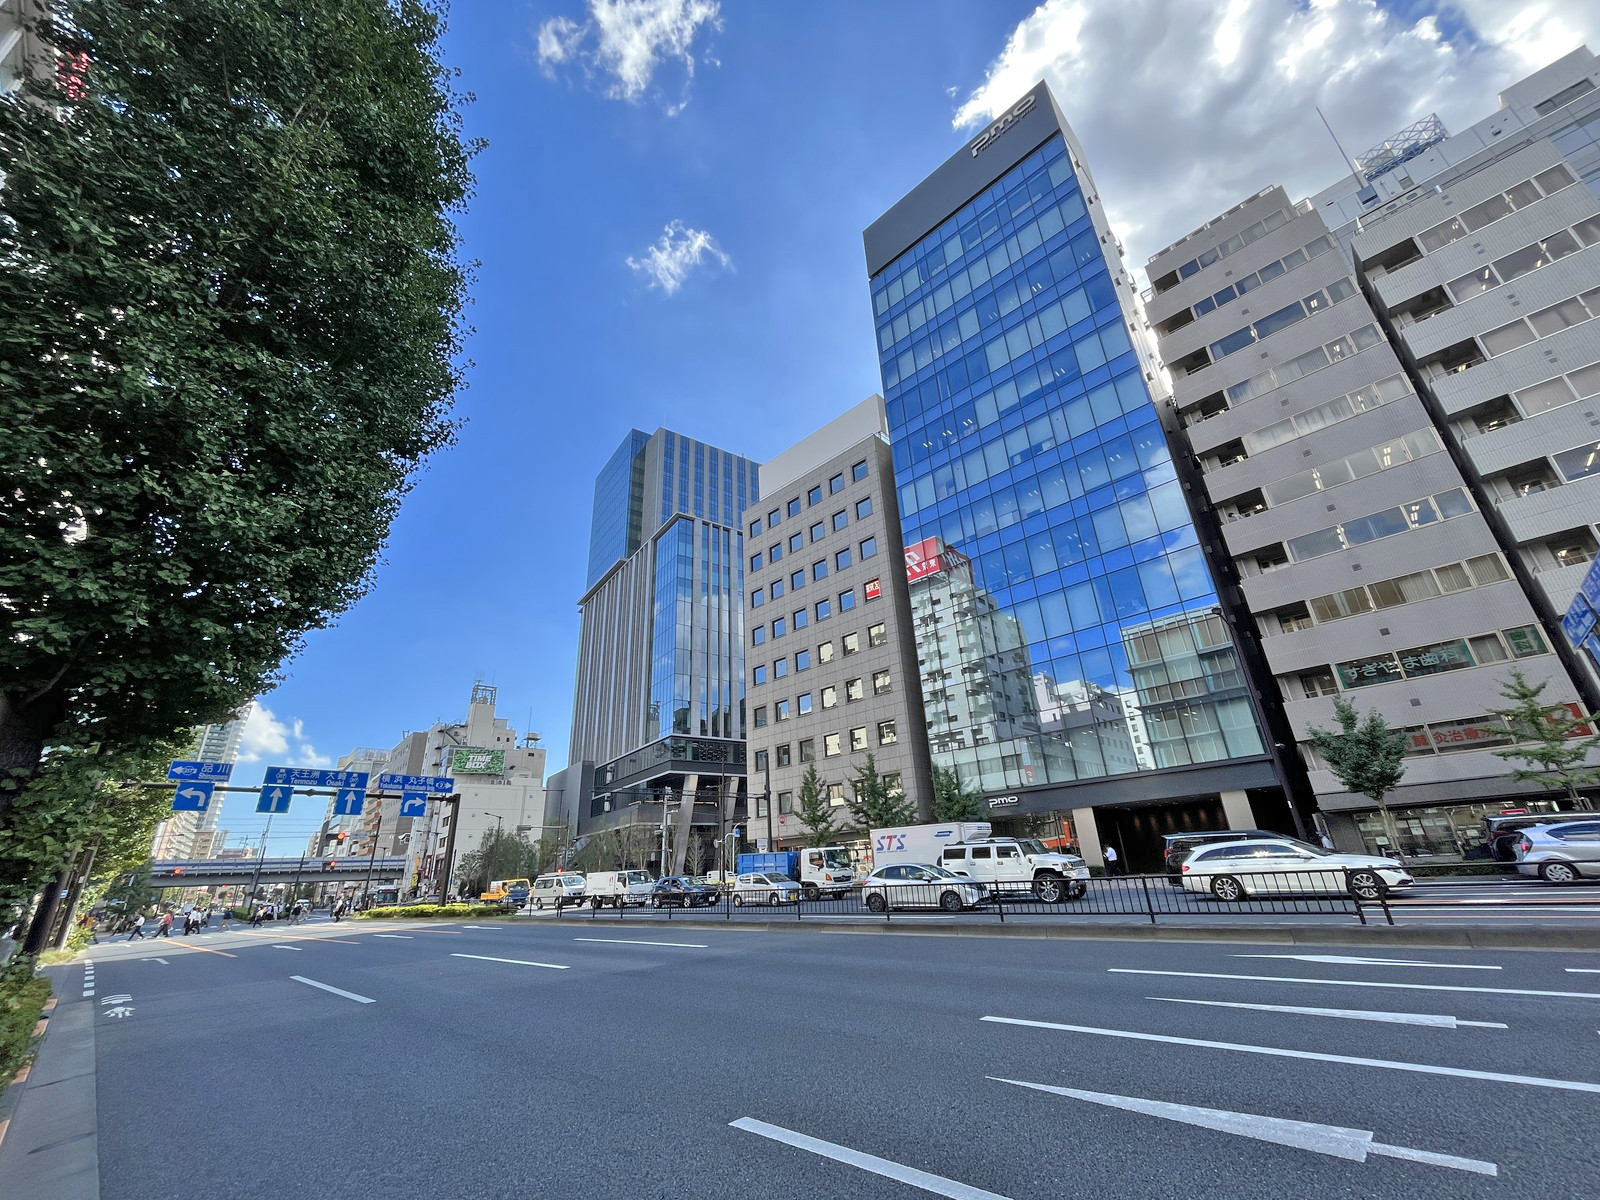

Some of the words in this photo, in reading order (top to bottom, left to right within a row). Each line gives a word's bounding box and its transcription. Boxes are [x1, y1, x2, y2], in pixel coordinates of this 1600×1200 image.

[1344, 649, 1460, 680] すぎやま歯科
[201, 763, 230, 774] 品川
[290, 769, 320, 779] 天王洲
[876, 834, 907, 851] STS
